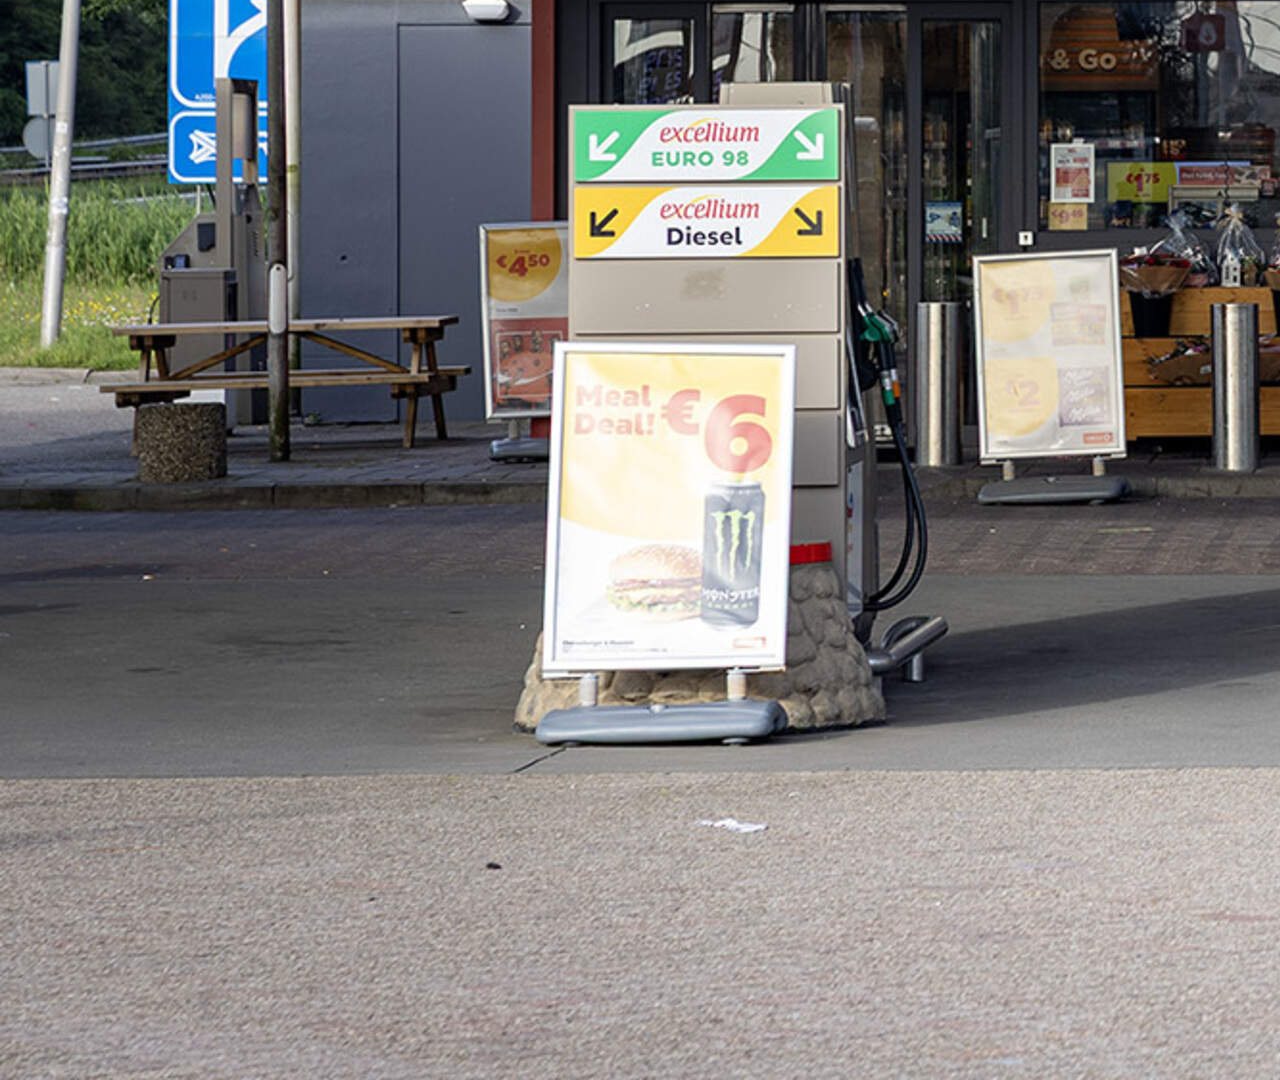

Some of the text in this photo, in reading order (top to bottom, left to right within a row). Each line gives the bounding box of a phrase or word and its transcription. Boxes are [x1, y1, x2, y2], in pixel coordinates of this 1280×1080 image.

[1050, 48, 1117, 71] & Go
[660, 121, 760, 143] excellium
[651, 151, 749, 167] EURO 98
[660, 198, 760, 220] excellium
[666, 226, 743, 246] Diesel
[575, 385, 650, 407] Meal
[574, 413, 655, 435] Deal!
